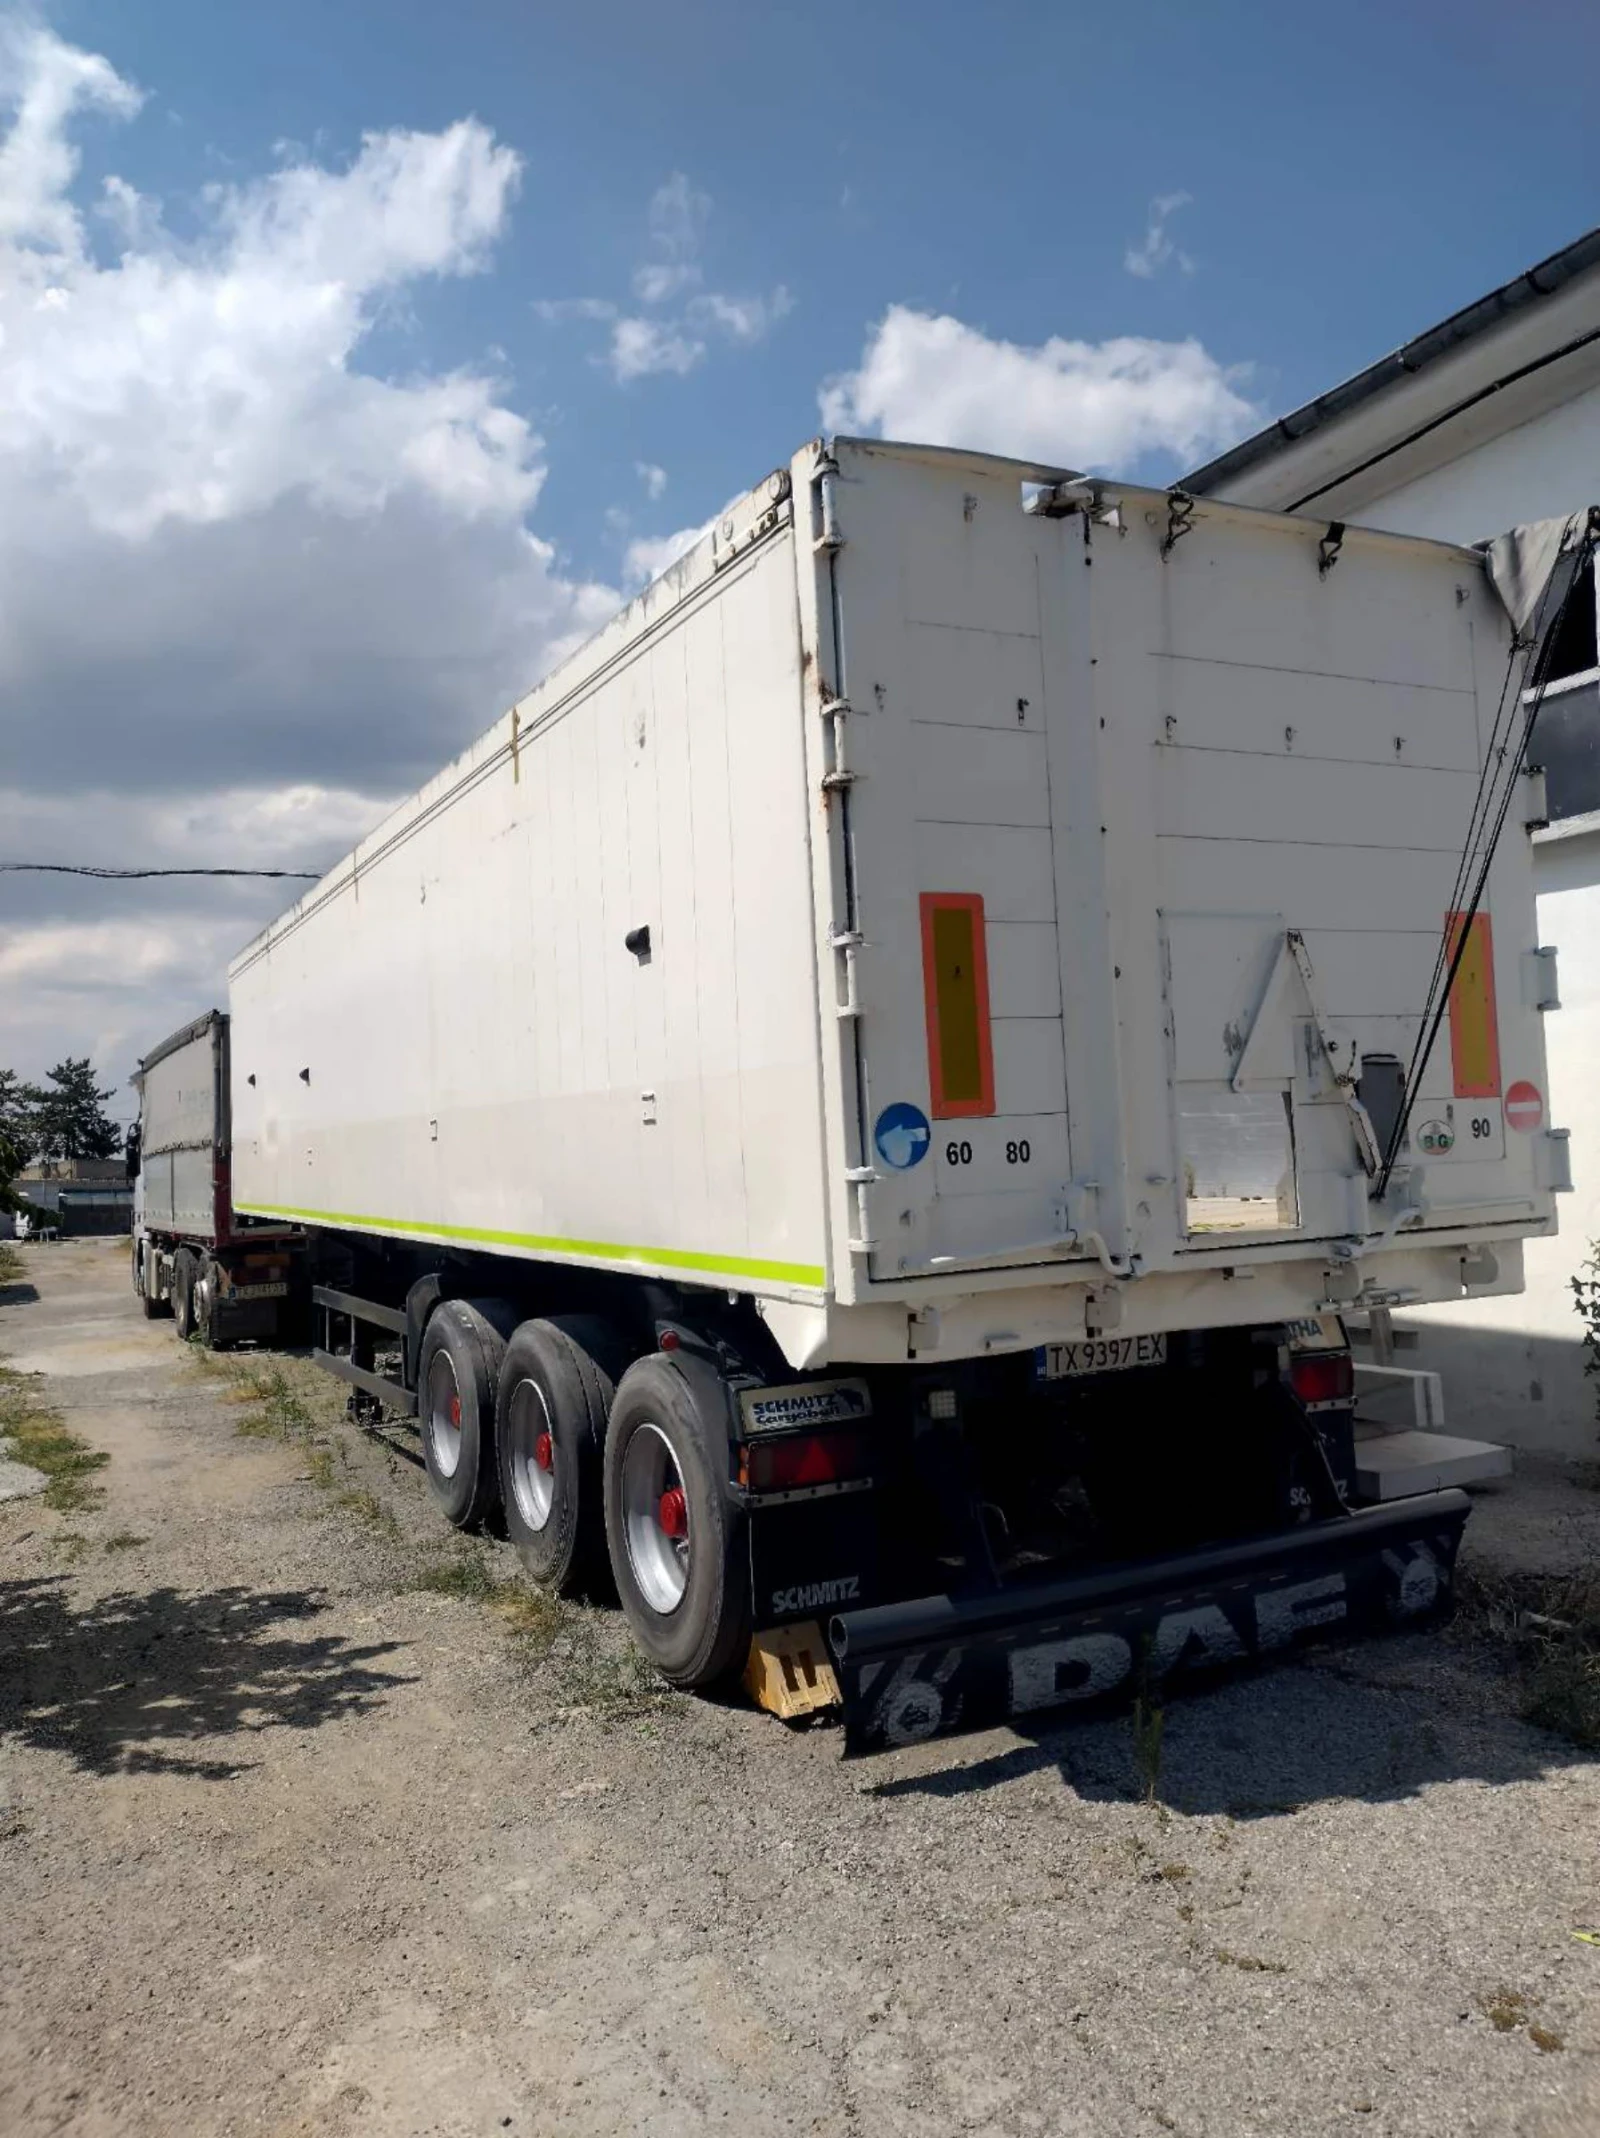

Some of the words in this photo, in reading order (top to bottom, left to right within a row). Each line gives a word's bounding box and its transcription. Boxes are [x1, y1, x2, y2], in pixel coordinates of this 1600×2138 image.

[1471, 1118, 1490, 1139] 90
[946, 1141, 972, 1166] 60
[1006, 1140, 1030, 1164] 80
[1050, 1345, 1077, 1372] TX
[1083, 1338, 1132, 1368] 9397
[1137, 1333, 1163, 1360] EX
[753, 1394, 838, 1415] SCHMITZ
[772, 1575, 861, 1614] SCHMITZ
[1007, 1572, 1347, 1716] DAF
